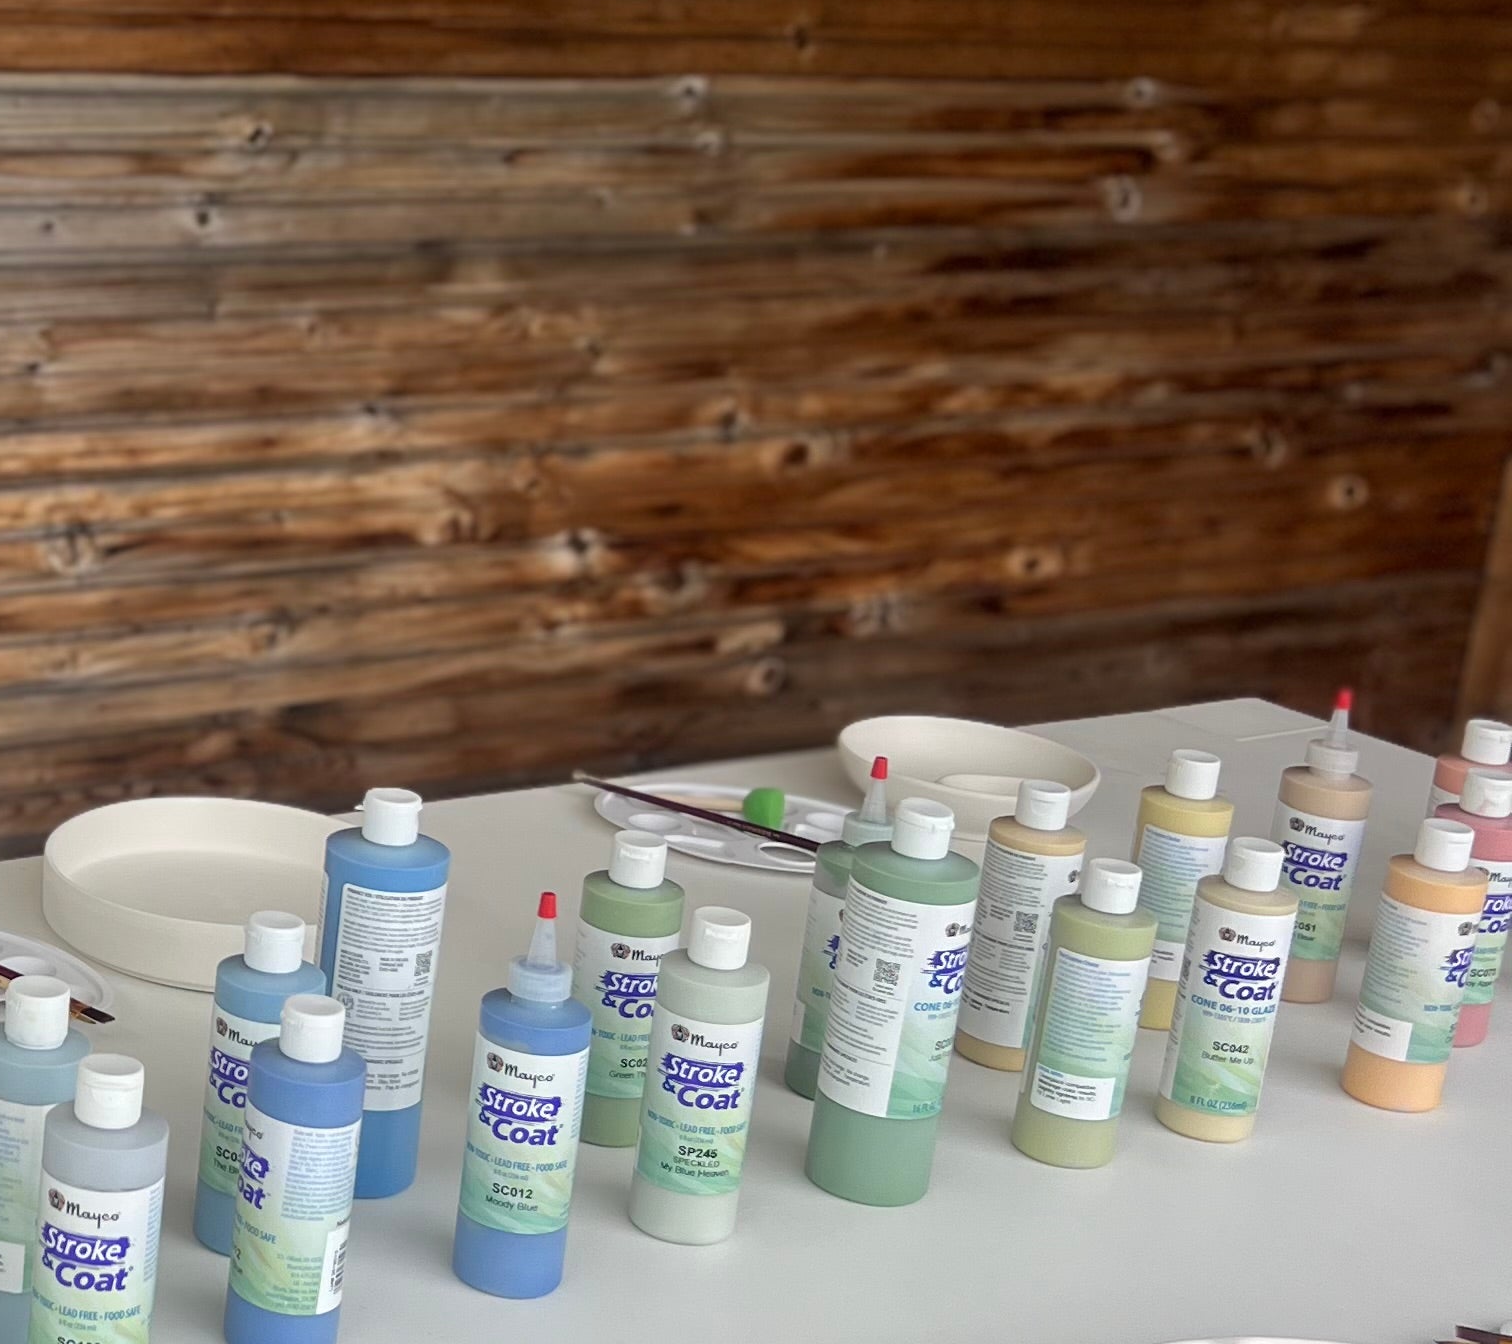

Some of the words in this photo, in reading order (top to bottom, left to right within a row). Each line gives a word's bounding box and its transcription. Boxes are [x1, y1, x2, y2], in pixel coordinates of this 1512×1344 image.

[1305, 824, 1345, 845] Mayco
[1287, 843, 1343, 870] Stroke
[1289, 867, 1343, 891] Coat
[1489, 872, 1512, 889] May
[1294, 920, 1317, 932] 051
[1236, 934, 1275, 952] Mayco
[1209, 953, 1274, 978] Stroke
[606, 973, 658, 994] Strok
[1203, 972, 1218, 987] &
[1219, 980, 1276, 1001] Coat
[601, 996, 617, 1008] &
[618, 998, 654, 1019] Co
[1191, 994, 1217, 1010] CONE
[1220, 1003, 1249, 1015] 06-10
[1251, 1004, 1276, 1016] GLAZE
[690, 1033, 738, 1057] Mayco
[1212, 1041, 1249, 1054] SC042
[213, 1050, 249, 1082] Stro
[619, 1058, 648, 1068] SC02
[667, 1056, 738, 1085] Stroke
[504, 1062, 555, 1088] Mayco
[217, 1081, 247, 1109] Co
[483, 1087, 555, 1119] Stroke
[662, 1078, 676, 1094] &
[677, 1086, 741, 1110] Coat
[479, 1110, 491, 1126] &
[492, 1118, 560, 1146] Coat
[679, 1122, 697, 1134] LEAD
[698, 1126, 716, 1136] FREE
[673, 1156, 720, 1169] SPECKLED
[678, 1145, 718, 1159] SP245
[494, 1156, 512, 1169] LEAD
[513, 1159, 531, 1171] FREE
[535, 1162, 554, 1172] FOOD
[675, 1165, 695, 1177] Blue
[696, 1167, 729, 1177] Heaven
[492, 1182, 534, 1200] SC012
[66, 1200, 120, 1229] Mayco
[485, 1195, 515, 1211] Moody
[517, 1200, 539, 1212] Blue
[45, 1226, 119, 1262] Stroke
[260, 1229, 277, 1245] SAFE
[41, 1251, 54, 1270] &
[55, 1262, 128, 1292] Coat
[58, 1306, 77, 1319] LEAD
[79, 1308, 98, 1321] FREE
[104, 1309, 125, 1321] FOOD
[125, 1305, 141, 1319] SAFE
